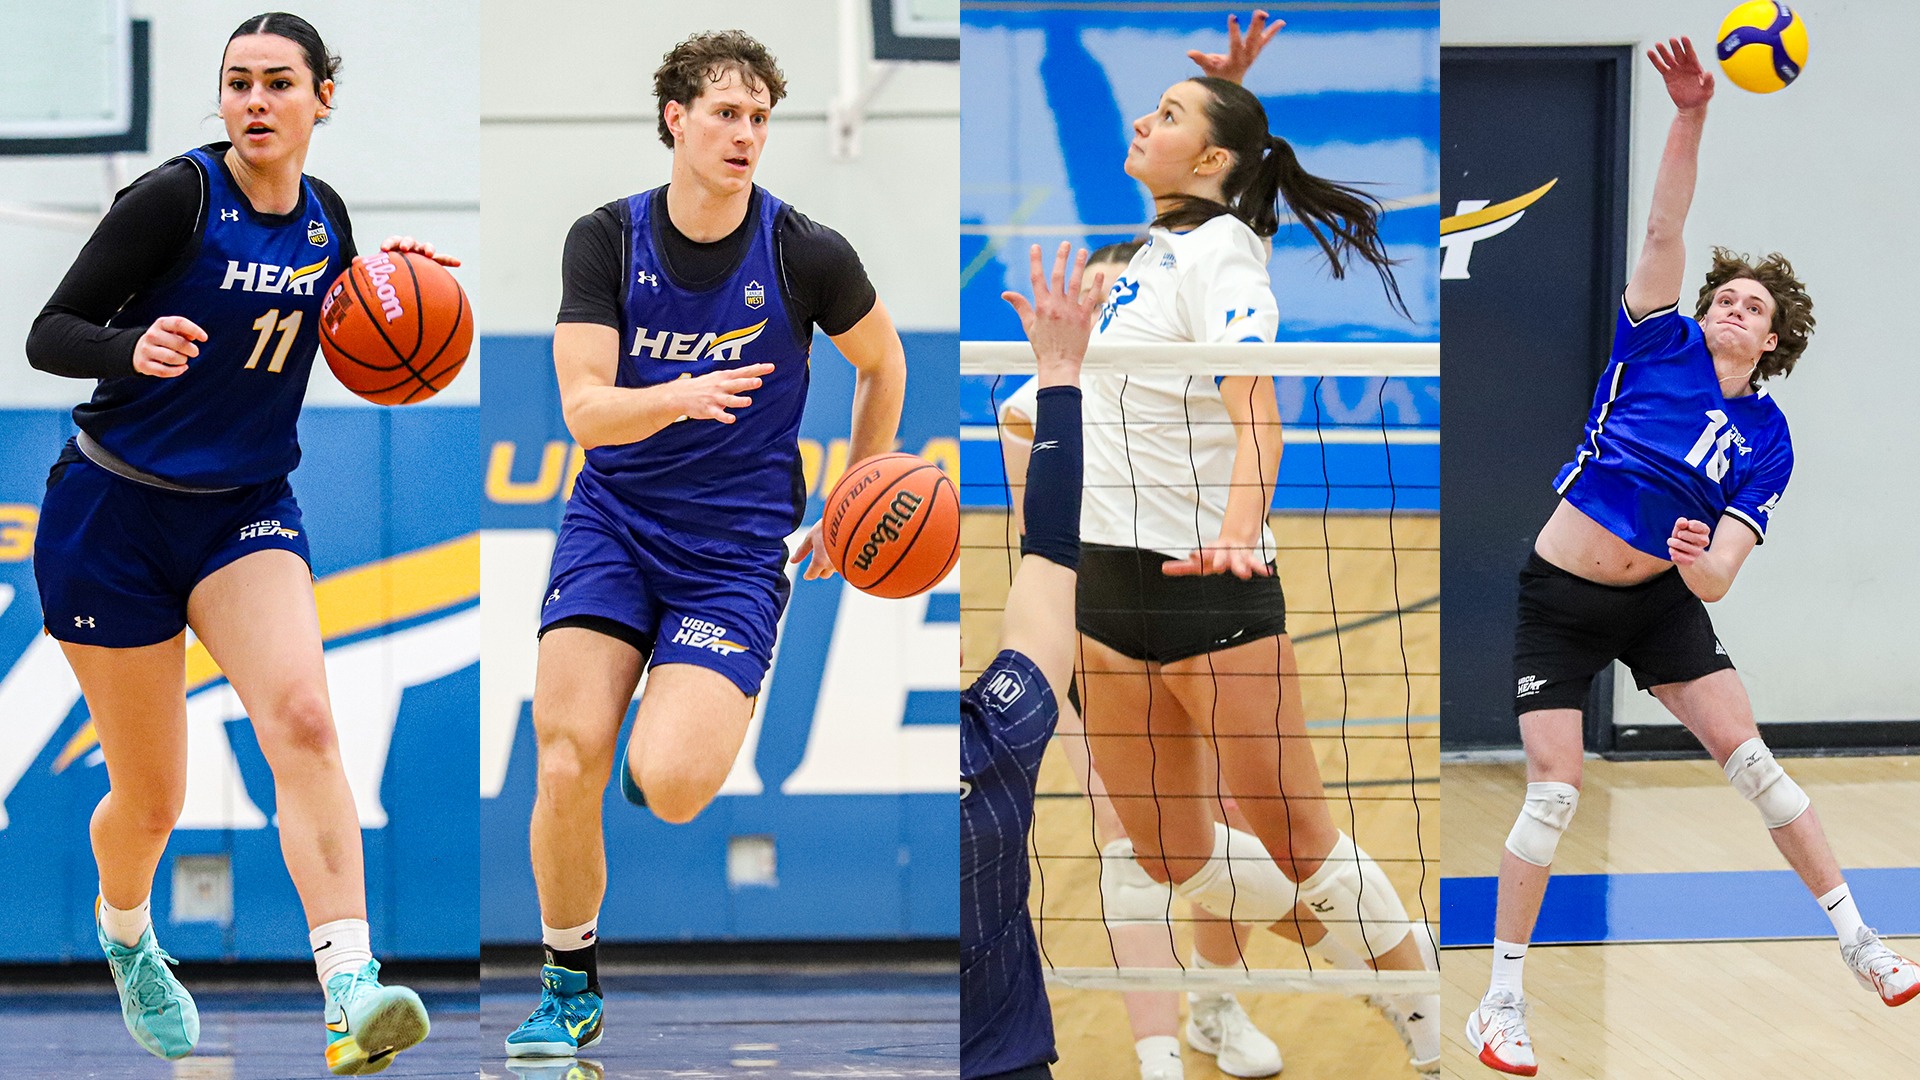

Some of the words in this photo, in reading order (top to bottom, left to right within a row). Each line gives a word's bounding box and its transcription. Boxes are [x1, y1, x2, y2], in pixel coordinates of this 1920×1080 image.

[219, 255, 330, 295] HEAT
[244, 308, 304, 373] 11
[629, 317, 769, 361] HEAT
[829, 470, 881, 548] EVOLUTION
[853, 489, 924, 571] Wilson
[239, 526, 299, 541] HEAT
[671, 628, 750, 657] HEAT
[681, 616, 727, 638] UBCO
